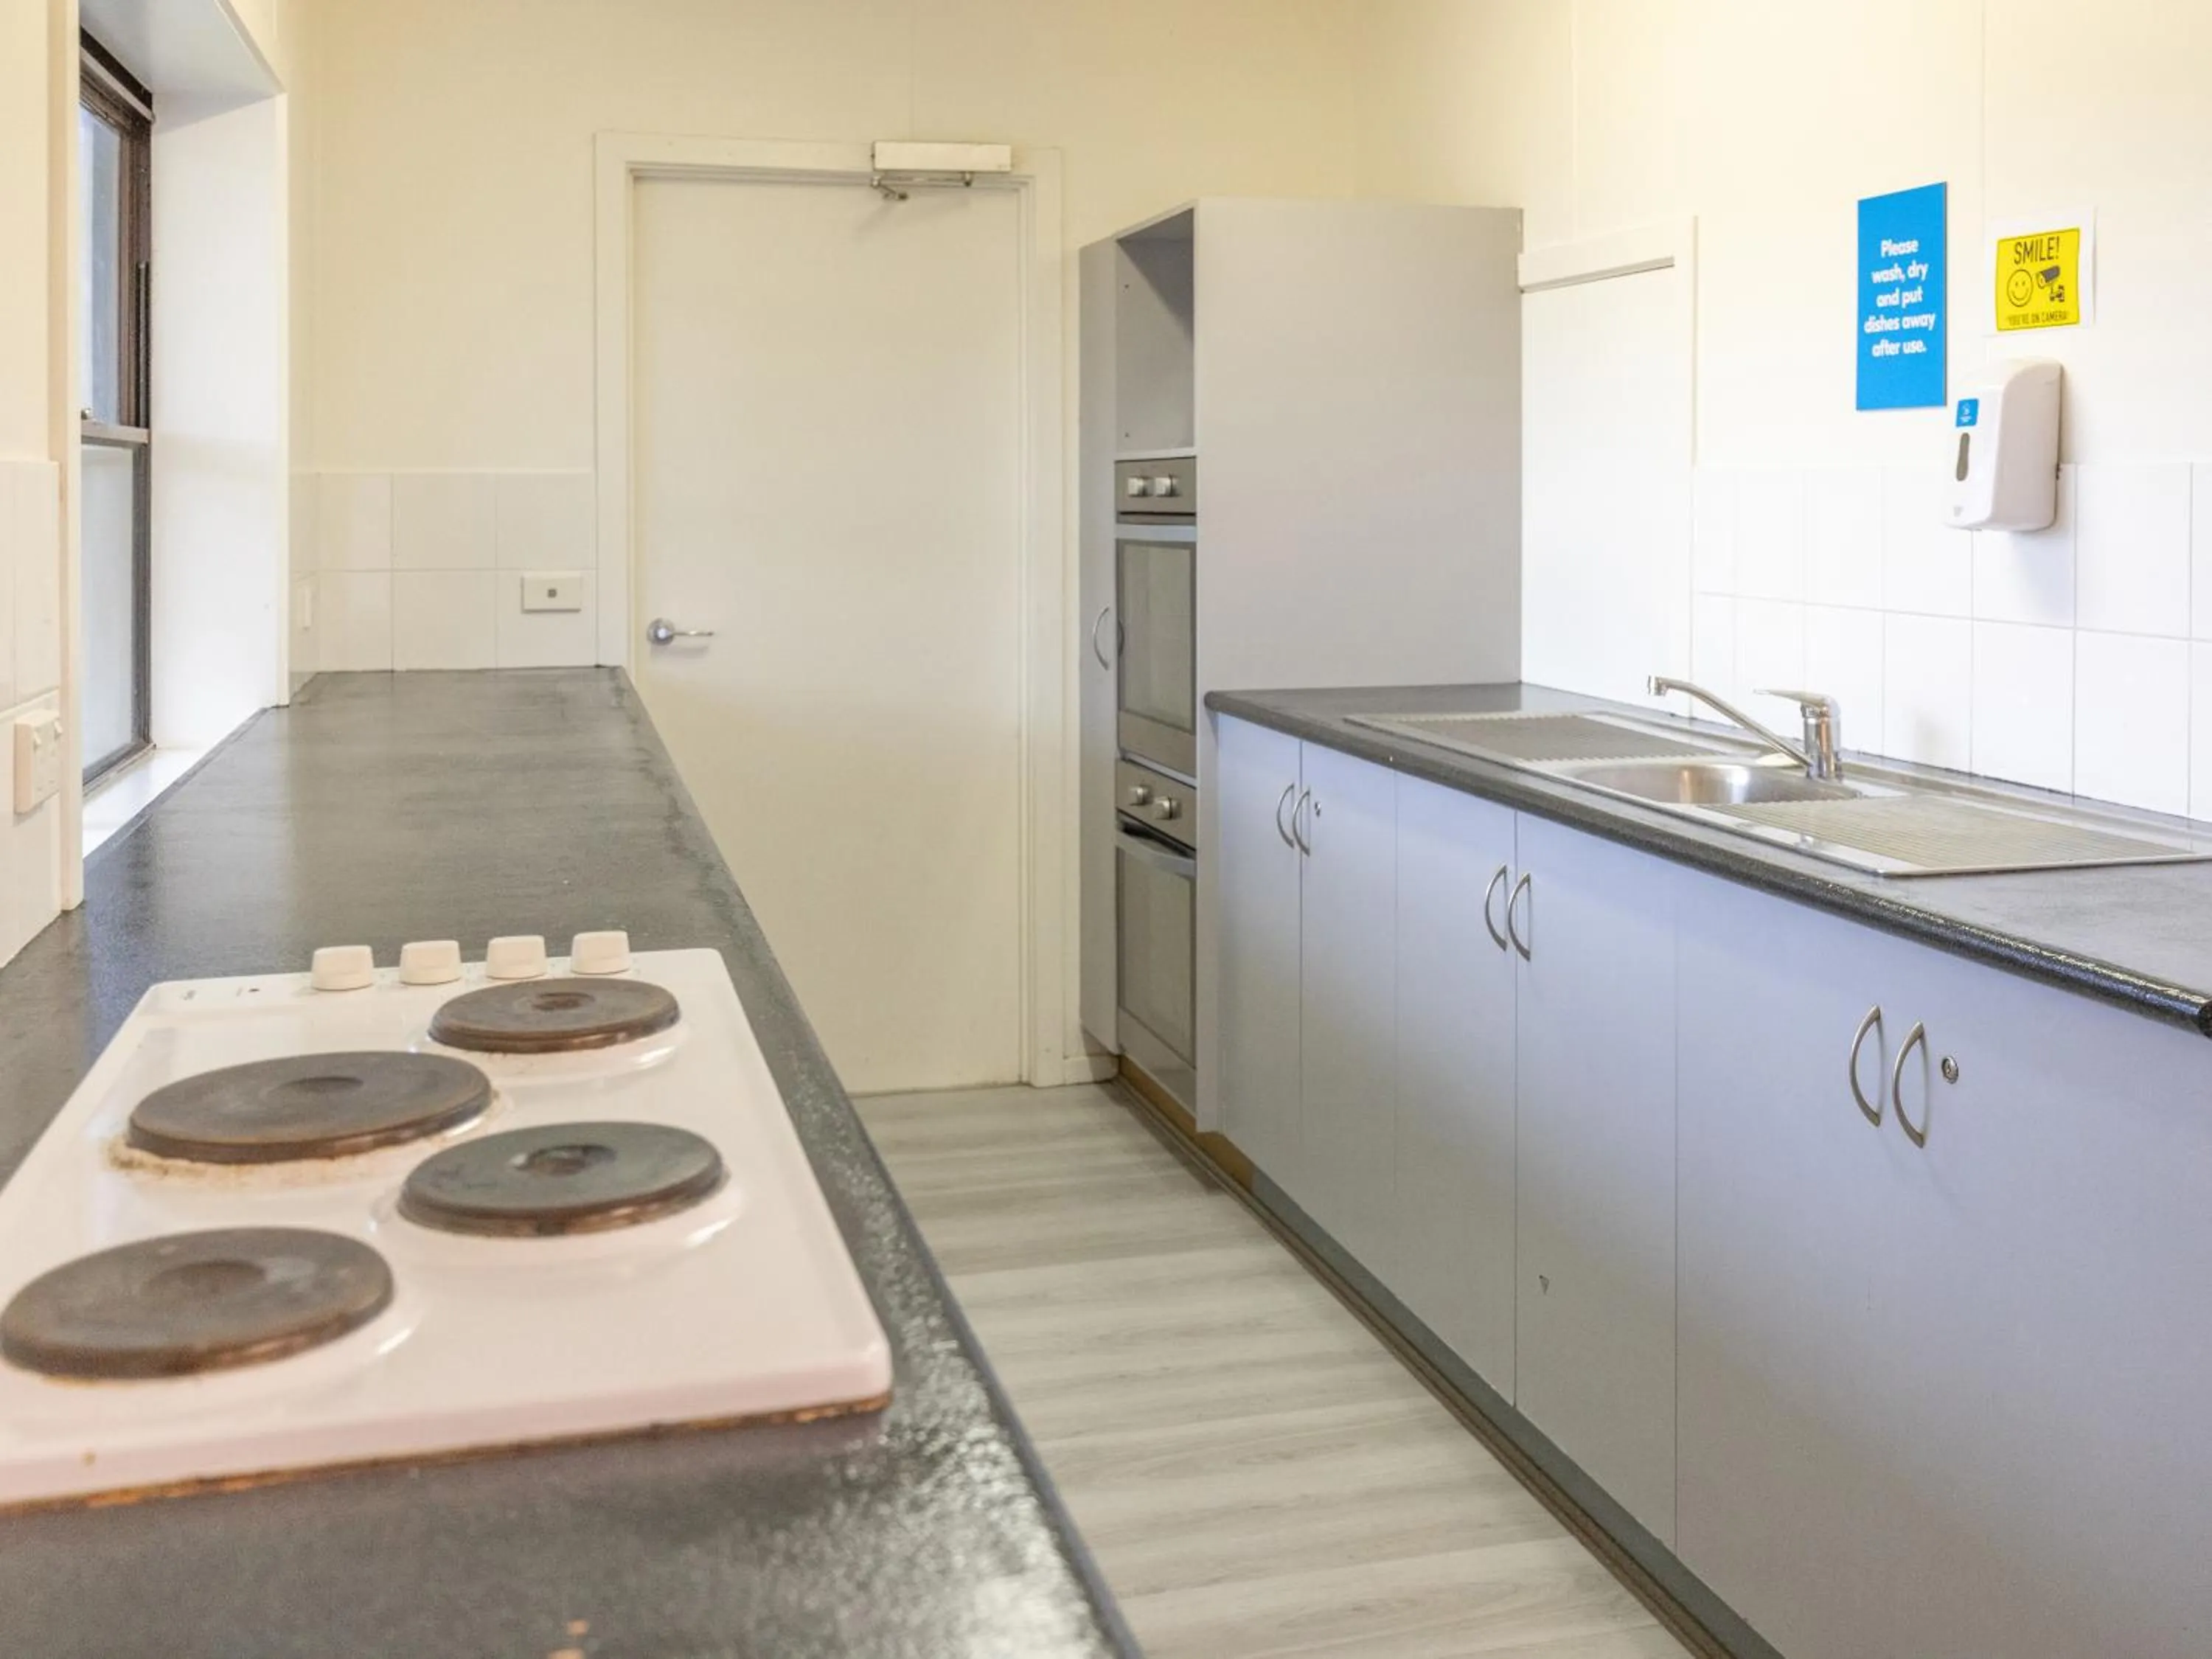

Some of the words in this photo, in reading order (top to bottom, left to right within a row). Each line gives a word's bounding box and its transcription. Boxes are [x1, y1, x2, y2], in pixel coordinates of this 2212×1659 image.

[1880, 239, 1919, 257] Please
[2014, 235, 2060, 265] SMILE!
[1871, 262, 1905, 283] wash,
[1907, 260, 1928, 281] dry
[1876, 288, 1900, 307] and
[1902, 286, 1923, 307] put
[1864, 315, 1900, 333] dishes
[1902, 313, 1935, 330] away
[1871, 338, 1902, 357] after
[1902, 340, 1927, 354] use.
